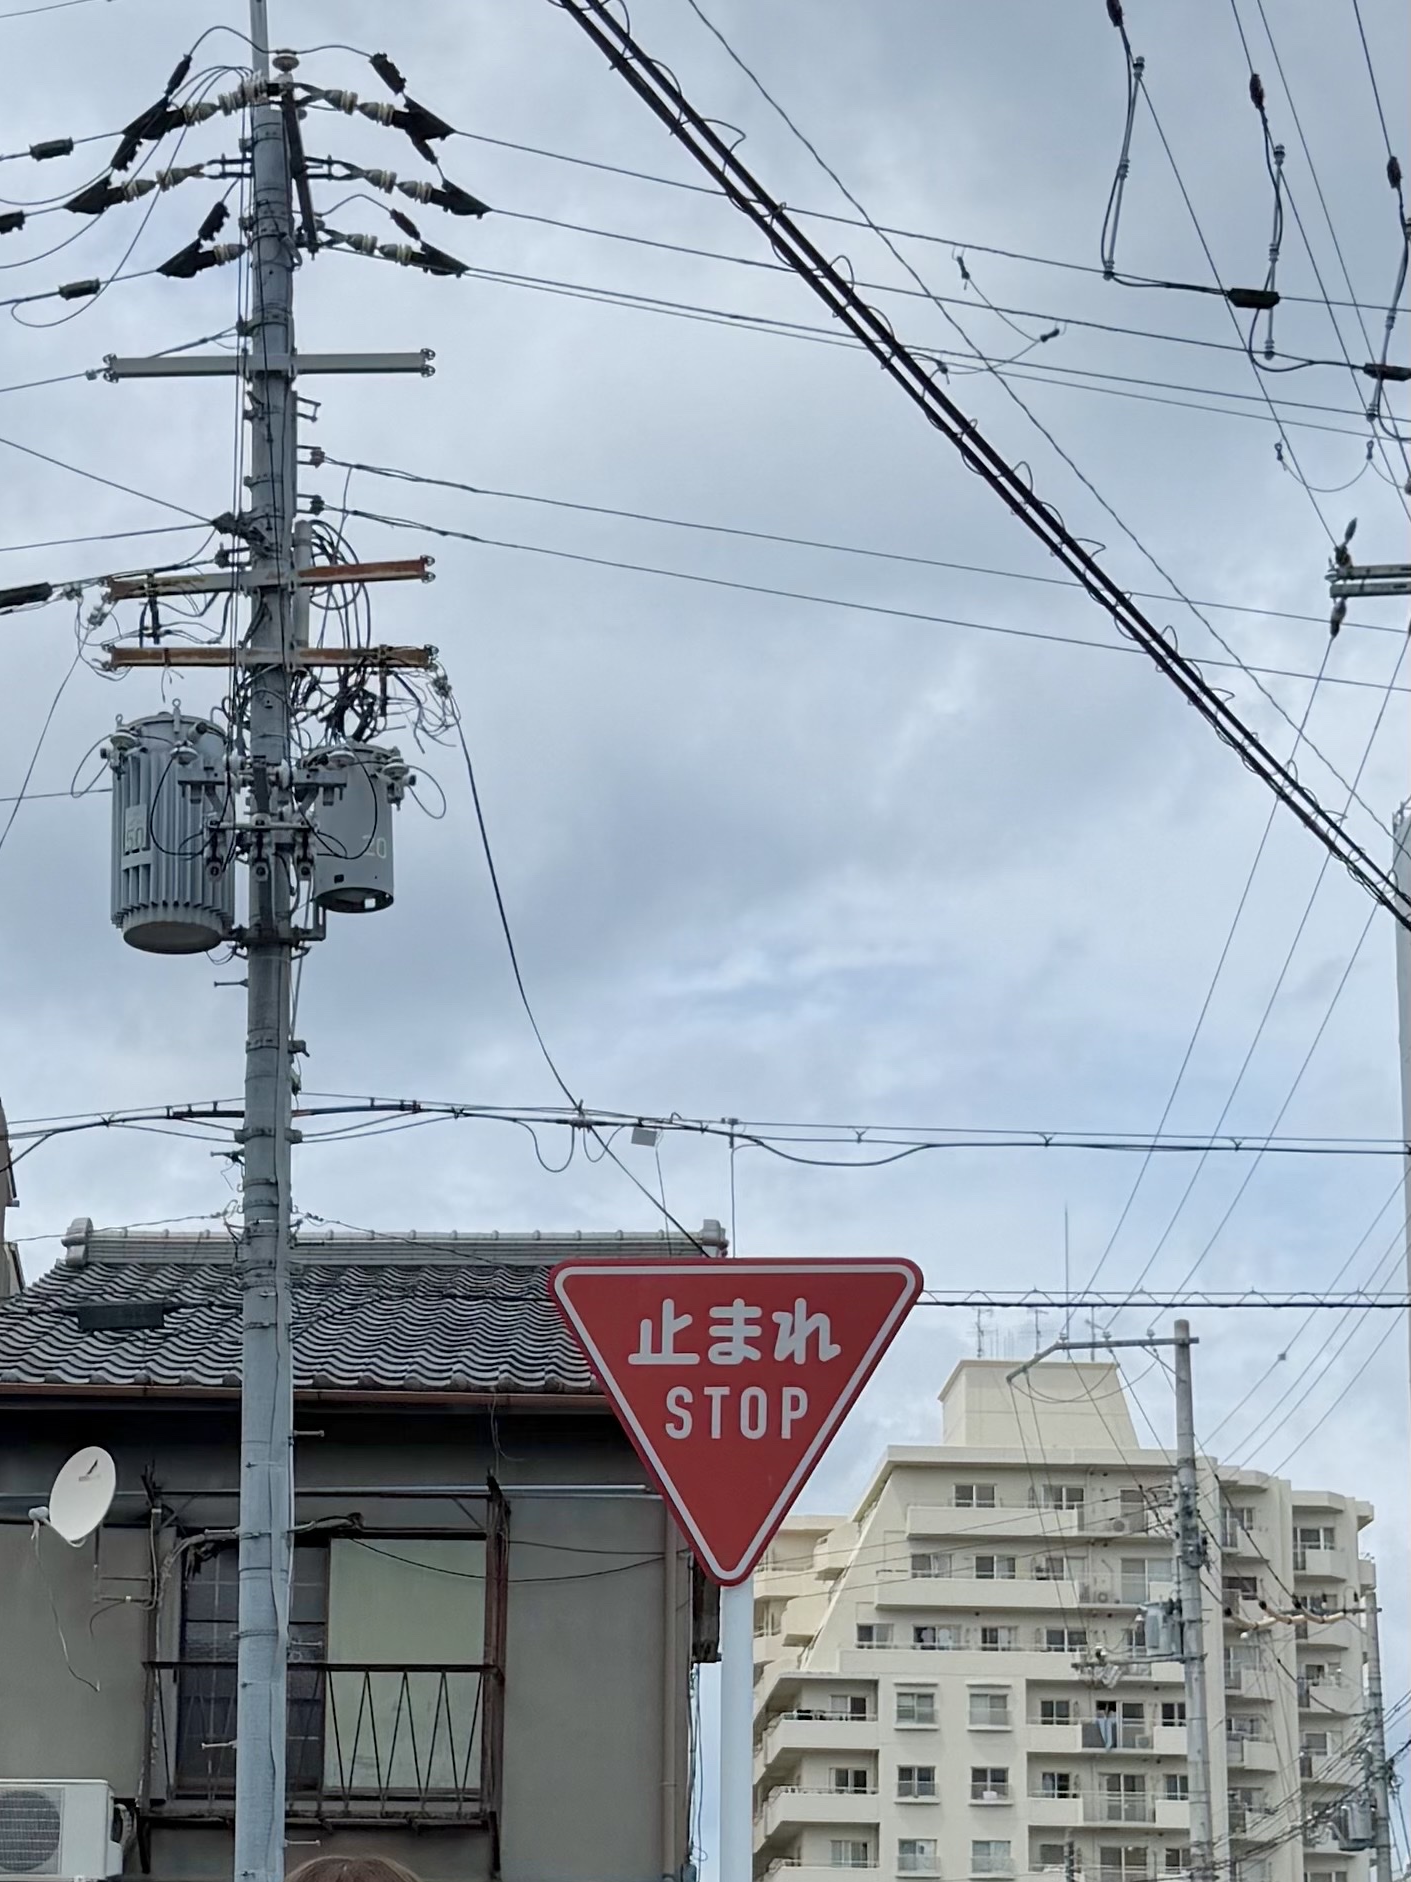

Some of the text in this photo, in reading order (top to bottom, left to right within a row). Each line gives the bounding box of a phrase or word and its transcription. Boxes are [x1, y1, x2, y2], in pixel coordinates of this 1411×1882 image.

[126, 827, 144, 852] 50
[362, 834, 387, 859] 20
[628, 1298, 842, 1366] 止まれ
[665, 1386, 809, 1440] STOP
